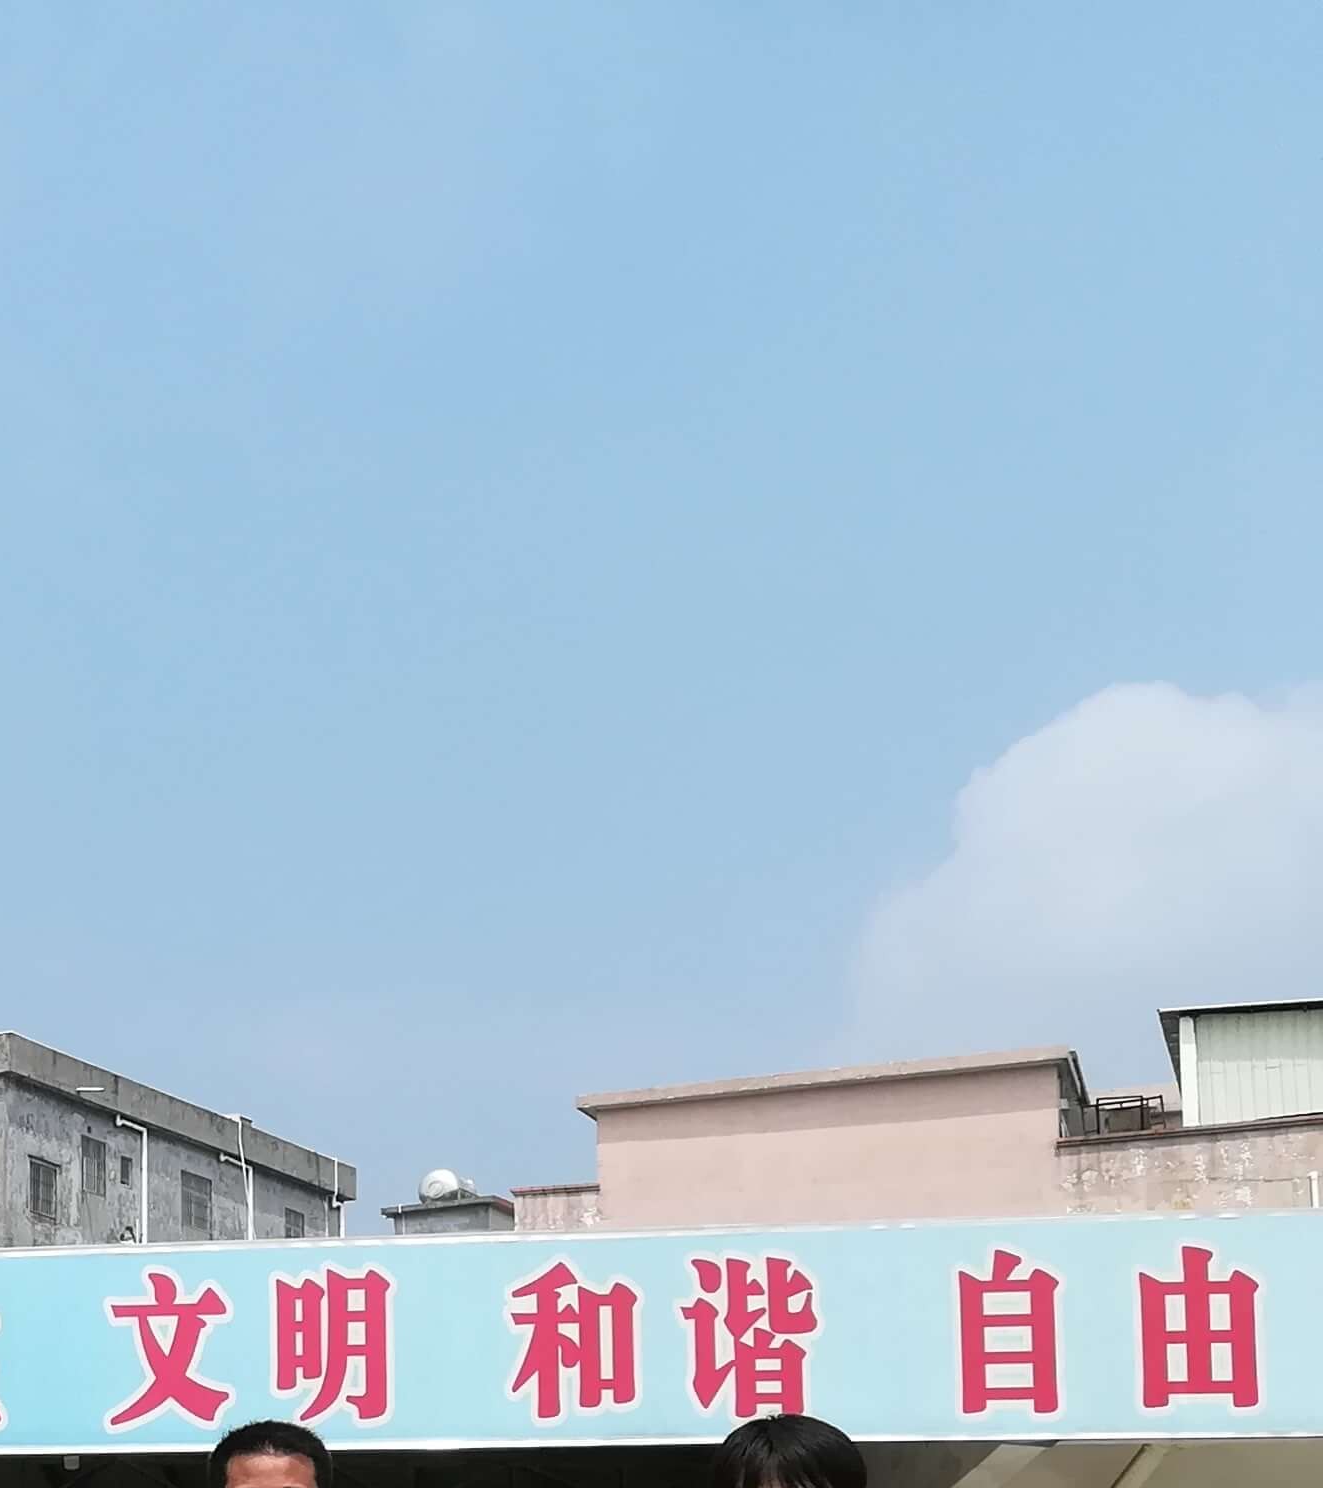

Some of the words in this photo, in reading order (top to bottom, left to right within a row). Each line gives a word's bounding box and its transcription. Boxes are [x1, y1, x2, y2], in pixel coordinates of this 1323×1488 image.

[111, 1270, 390, 1426] 文明
[512, 1258, 817, 1418] 和谐
[959, 1247, 1258, 1412] 自由
